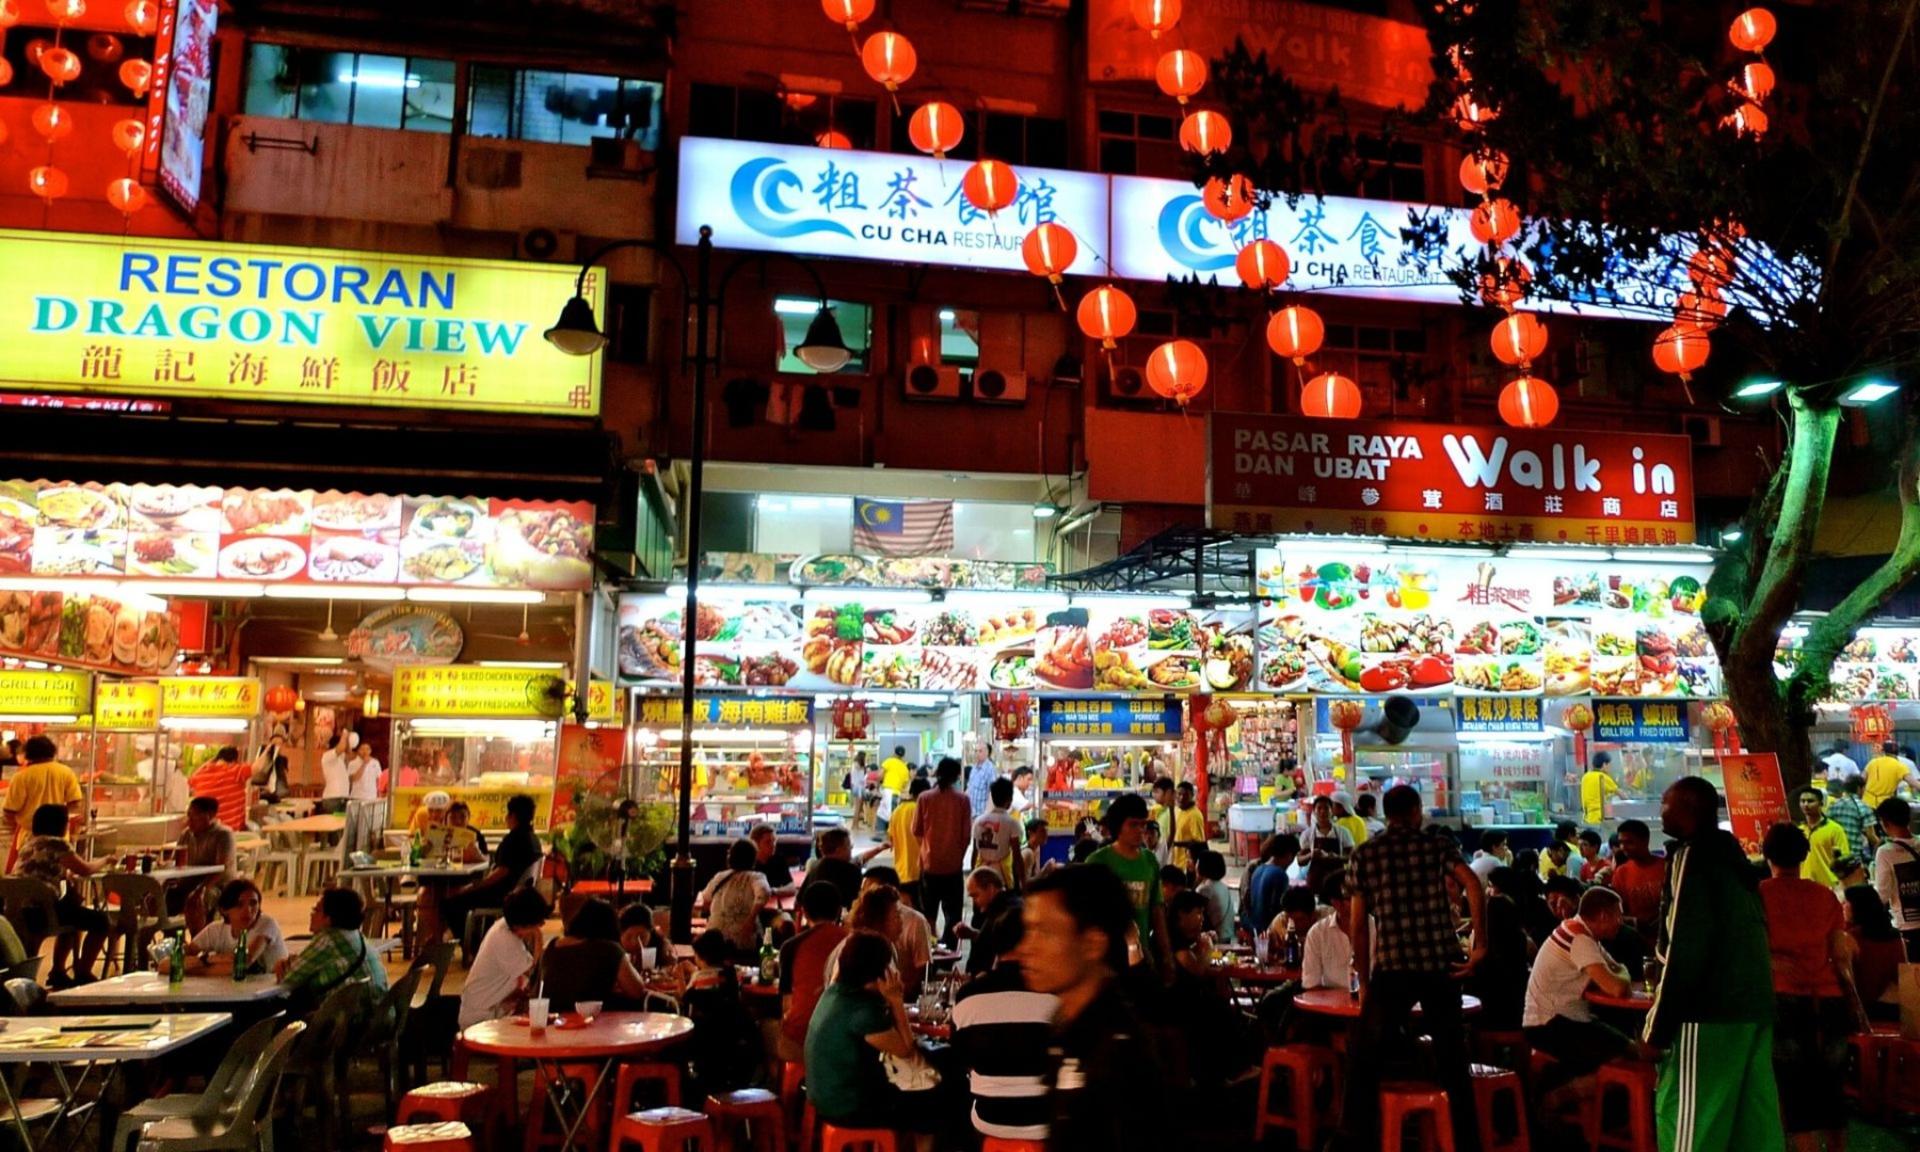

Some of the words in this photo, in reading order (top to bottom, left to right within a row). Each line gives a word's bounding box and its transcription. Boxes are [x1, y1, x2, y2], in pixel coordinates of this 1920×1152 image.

[861, 224, 892, 240] CU
[901, 228, 948, 245] CHA
[953, 231, 1024, 251] RESTAUR
[120, 252, 455, 309] RESTORAN
[1307, 262, 1349, 279] CHA
[31, 296, 324, 346] DRAGON
[357, 314, 529, 356] VIEW
[81, 345, 479, 397] 龍記海鮮飯店
[1234, 429, 1330, 454] PASAR
[1348, 434, 1423, 459] RAYA
[1235, 453, 1294, 475] DAN
[1314, 457, 1390, 480] UBAT
[1442, 434, 1602, 492] Walk
[1632, 446, 1675, 494] in
[1600, 727, 1619, 737] GRILL
[1620, 727, 1634, 737] FISH
[1640, 727, 1658, 737] FRIED
[1659, 727, 1685, 737] OYSTER
